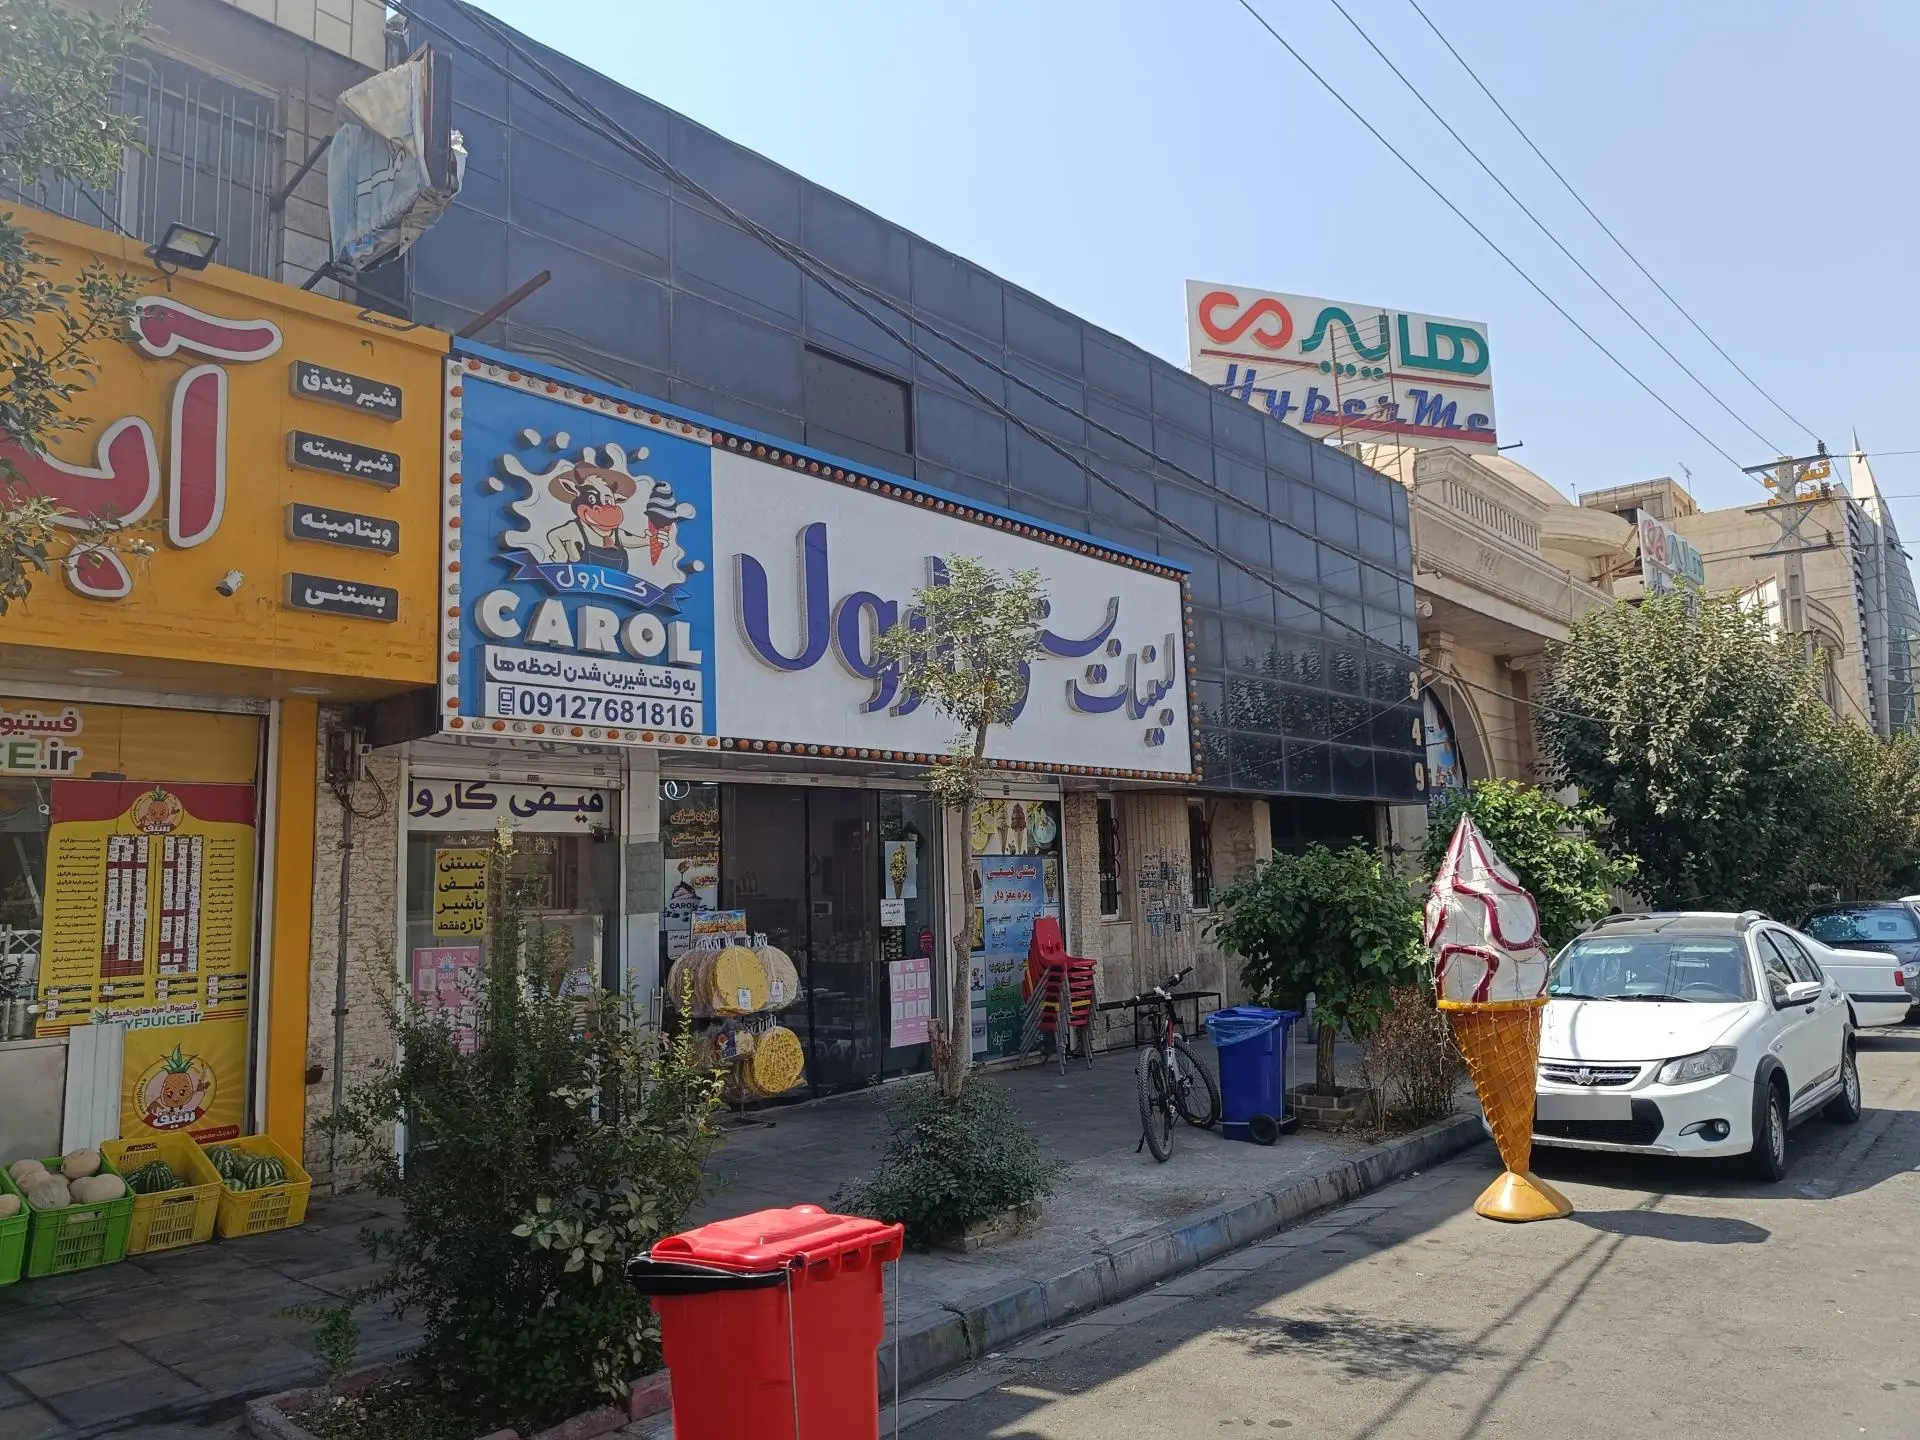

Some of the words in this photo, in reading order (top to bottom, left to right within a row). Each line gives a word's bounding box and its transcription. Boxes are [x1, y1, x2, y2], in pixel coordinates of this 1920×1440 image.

[302, 371, 355, 400] فندق
[355, 386, 397, 409] شیر
[302, 440, 353, 473] پسته
[355, 452, 394, 474] شیر
[301, 512, 392, 547] ویتامینه
[556, 569, 648, 599] کارول
[304, 586, 386, 614] بستنی
[475, 589, 703, 665] CAROL
[563, 662, 601, 683] شدن
[603, 668, 648, 692] شیرین
[649, 670, 681, 696] وقت
[682, 679, 696, 696] به
[519, 689, 695, 729] 09127681816
[0, 741, 78, 771] E.ir
[440, 857, 485, 874] بستنی
[438, 876, 485, 894] قیفی
